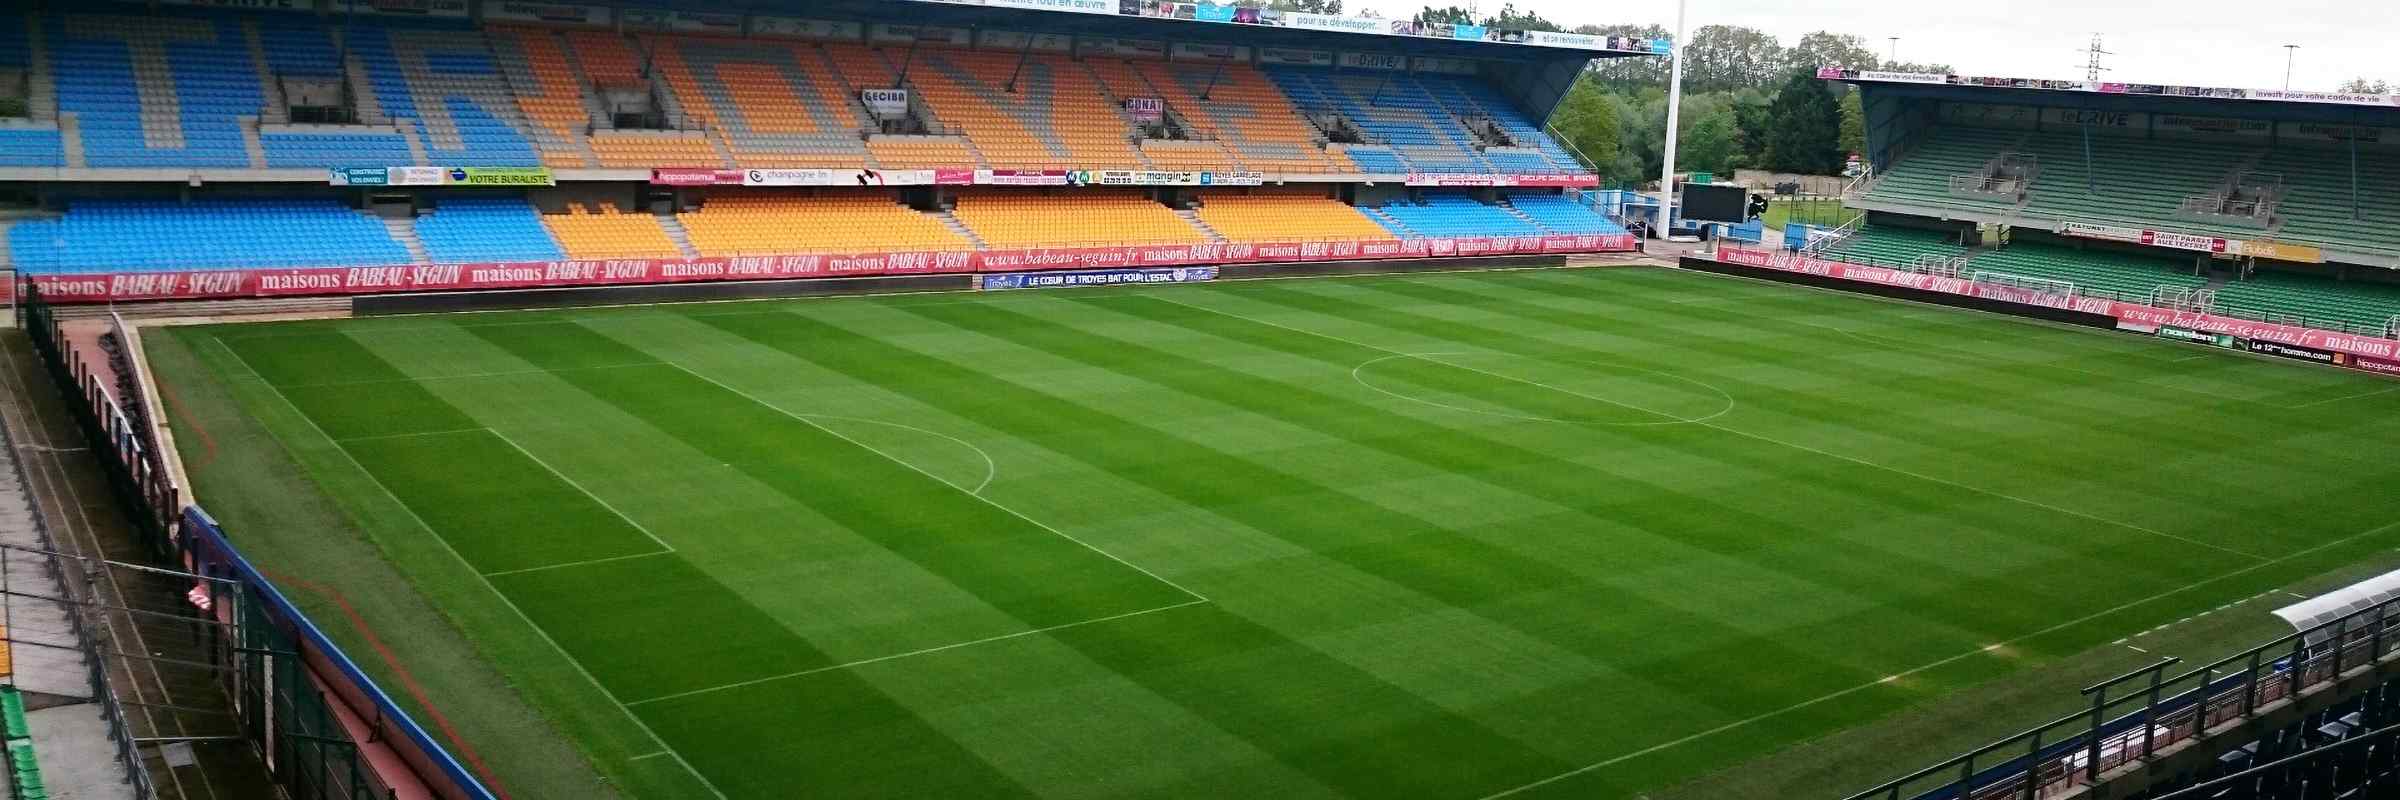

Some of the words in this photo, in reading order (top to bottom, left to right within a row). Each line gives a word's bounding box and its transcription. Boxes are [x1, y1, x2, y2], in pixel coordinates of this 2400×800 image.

[1297, 16, 1316, 26] pour
[469, 175, 498, 184] VOTRE
[501, 175, 549, 184] BURALISTE
[1146, 170, 1181, 183] mangin
[985, 250, 1138, 267] www.babeau-seguin.fr
[1144, 247, 1188, 262] maisons
[1259, 245, 1299, 258] maisons
[1727, 249, 1765, 266] maisons
[663, 259, 724, 276] maisons
[829, 256, 885, 272] maisons
[262, 271, 341, 289] maisons
[472, 264, 543, 283] maisons
[1029, 278, 1039, 286] LE
[1040, 276, 1063, 286] CŒUR
[1065, 276, 1076, 284] DE
[1078, 275, 1107, 284] TROYES
[1108, 274, 1122, 283] BAT
[1123, 273, 1144, 282] POUR
[1844, 266, 1889, 283] maisons
[1979, 287, 2028, 304] maisons
[2124, 309, 2317, 346] www.babeau-seguin.fr
[2325, 336, 2392, 357] maisons
[2251, 342, 2263, 350] Le
